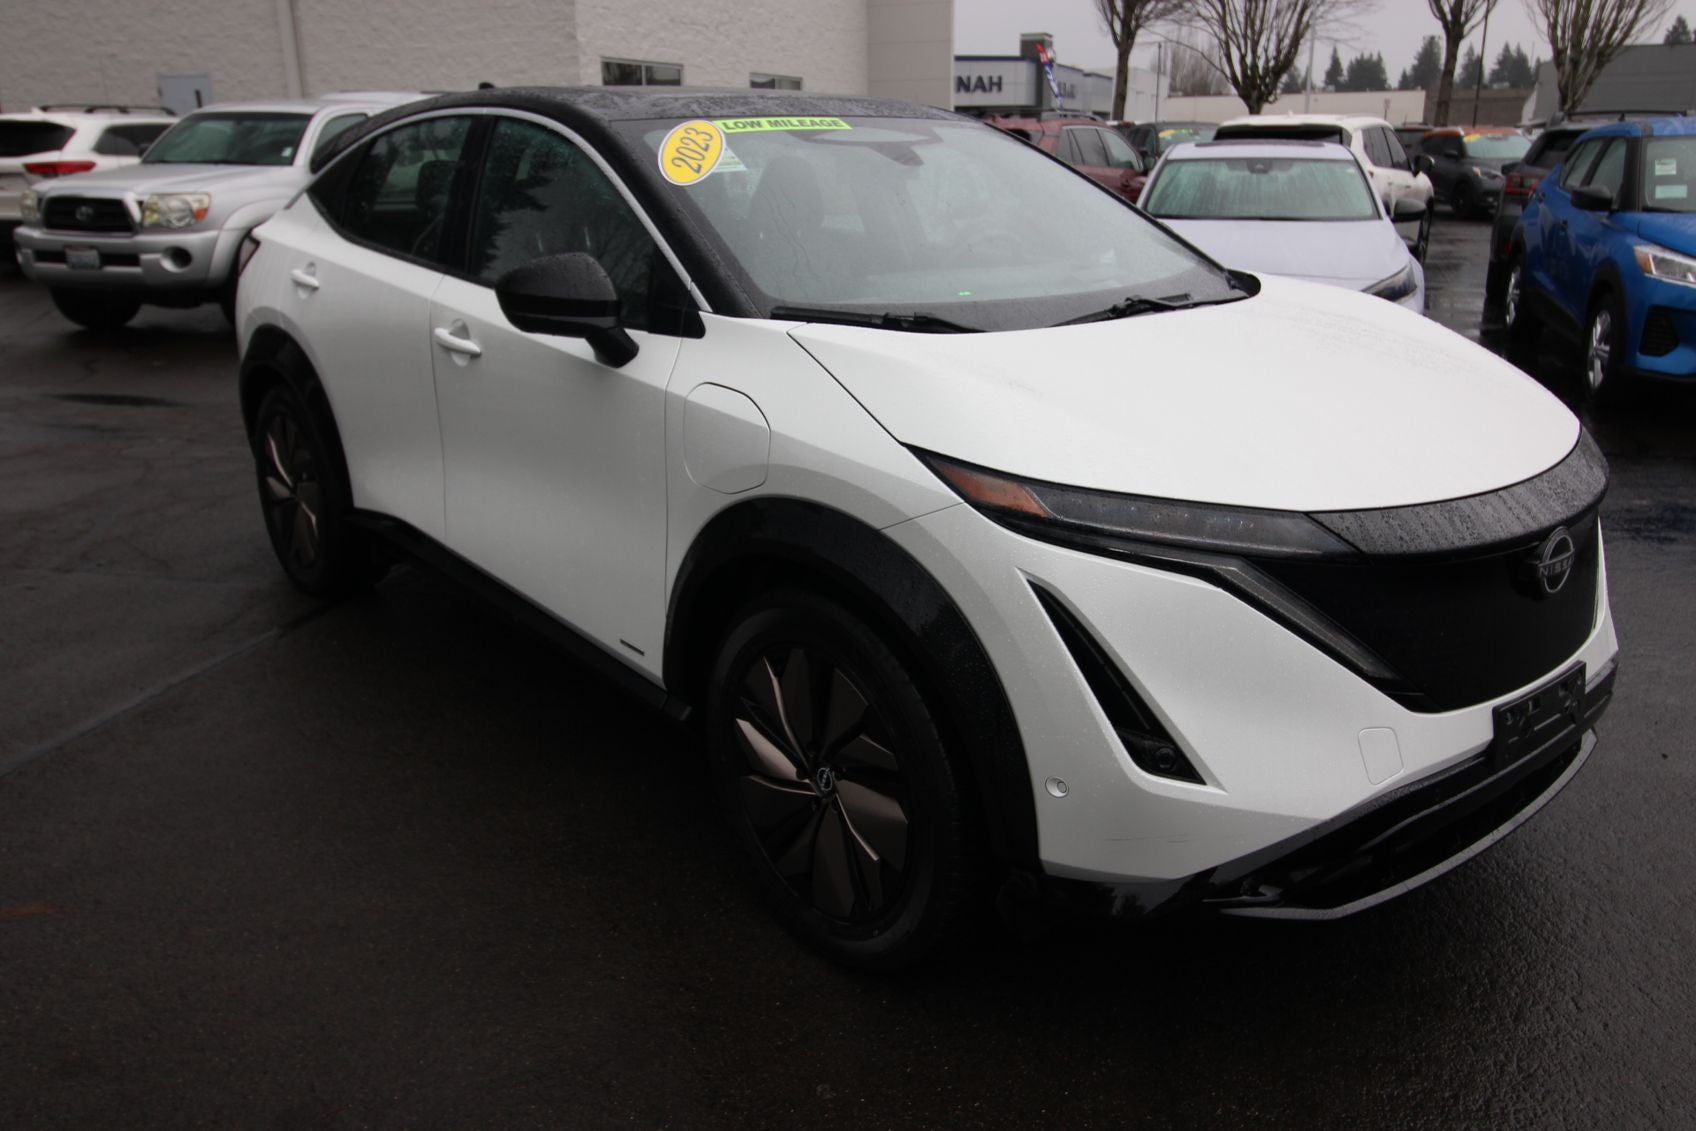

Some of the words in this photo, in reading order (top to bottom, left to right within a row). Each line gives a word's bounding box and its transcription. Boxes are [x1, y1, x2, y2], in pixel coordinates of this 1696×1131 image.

[956, 76, 1002, 93] NAH
[722, 120, 763, 130] LOW
[766, 119, 844, 128] MILEAGE
[671, 127, 713, 174] 2023
